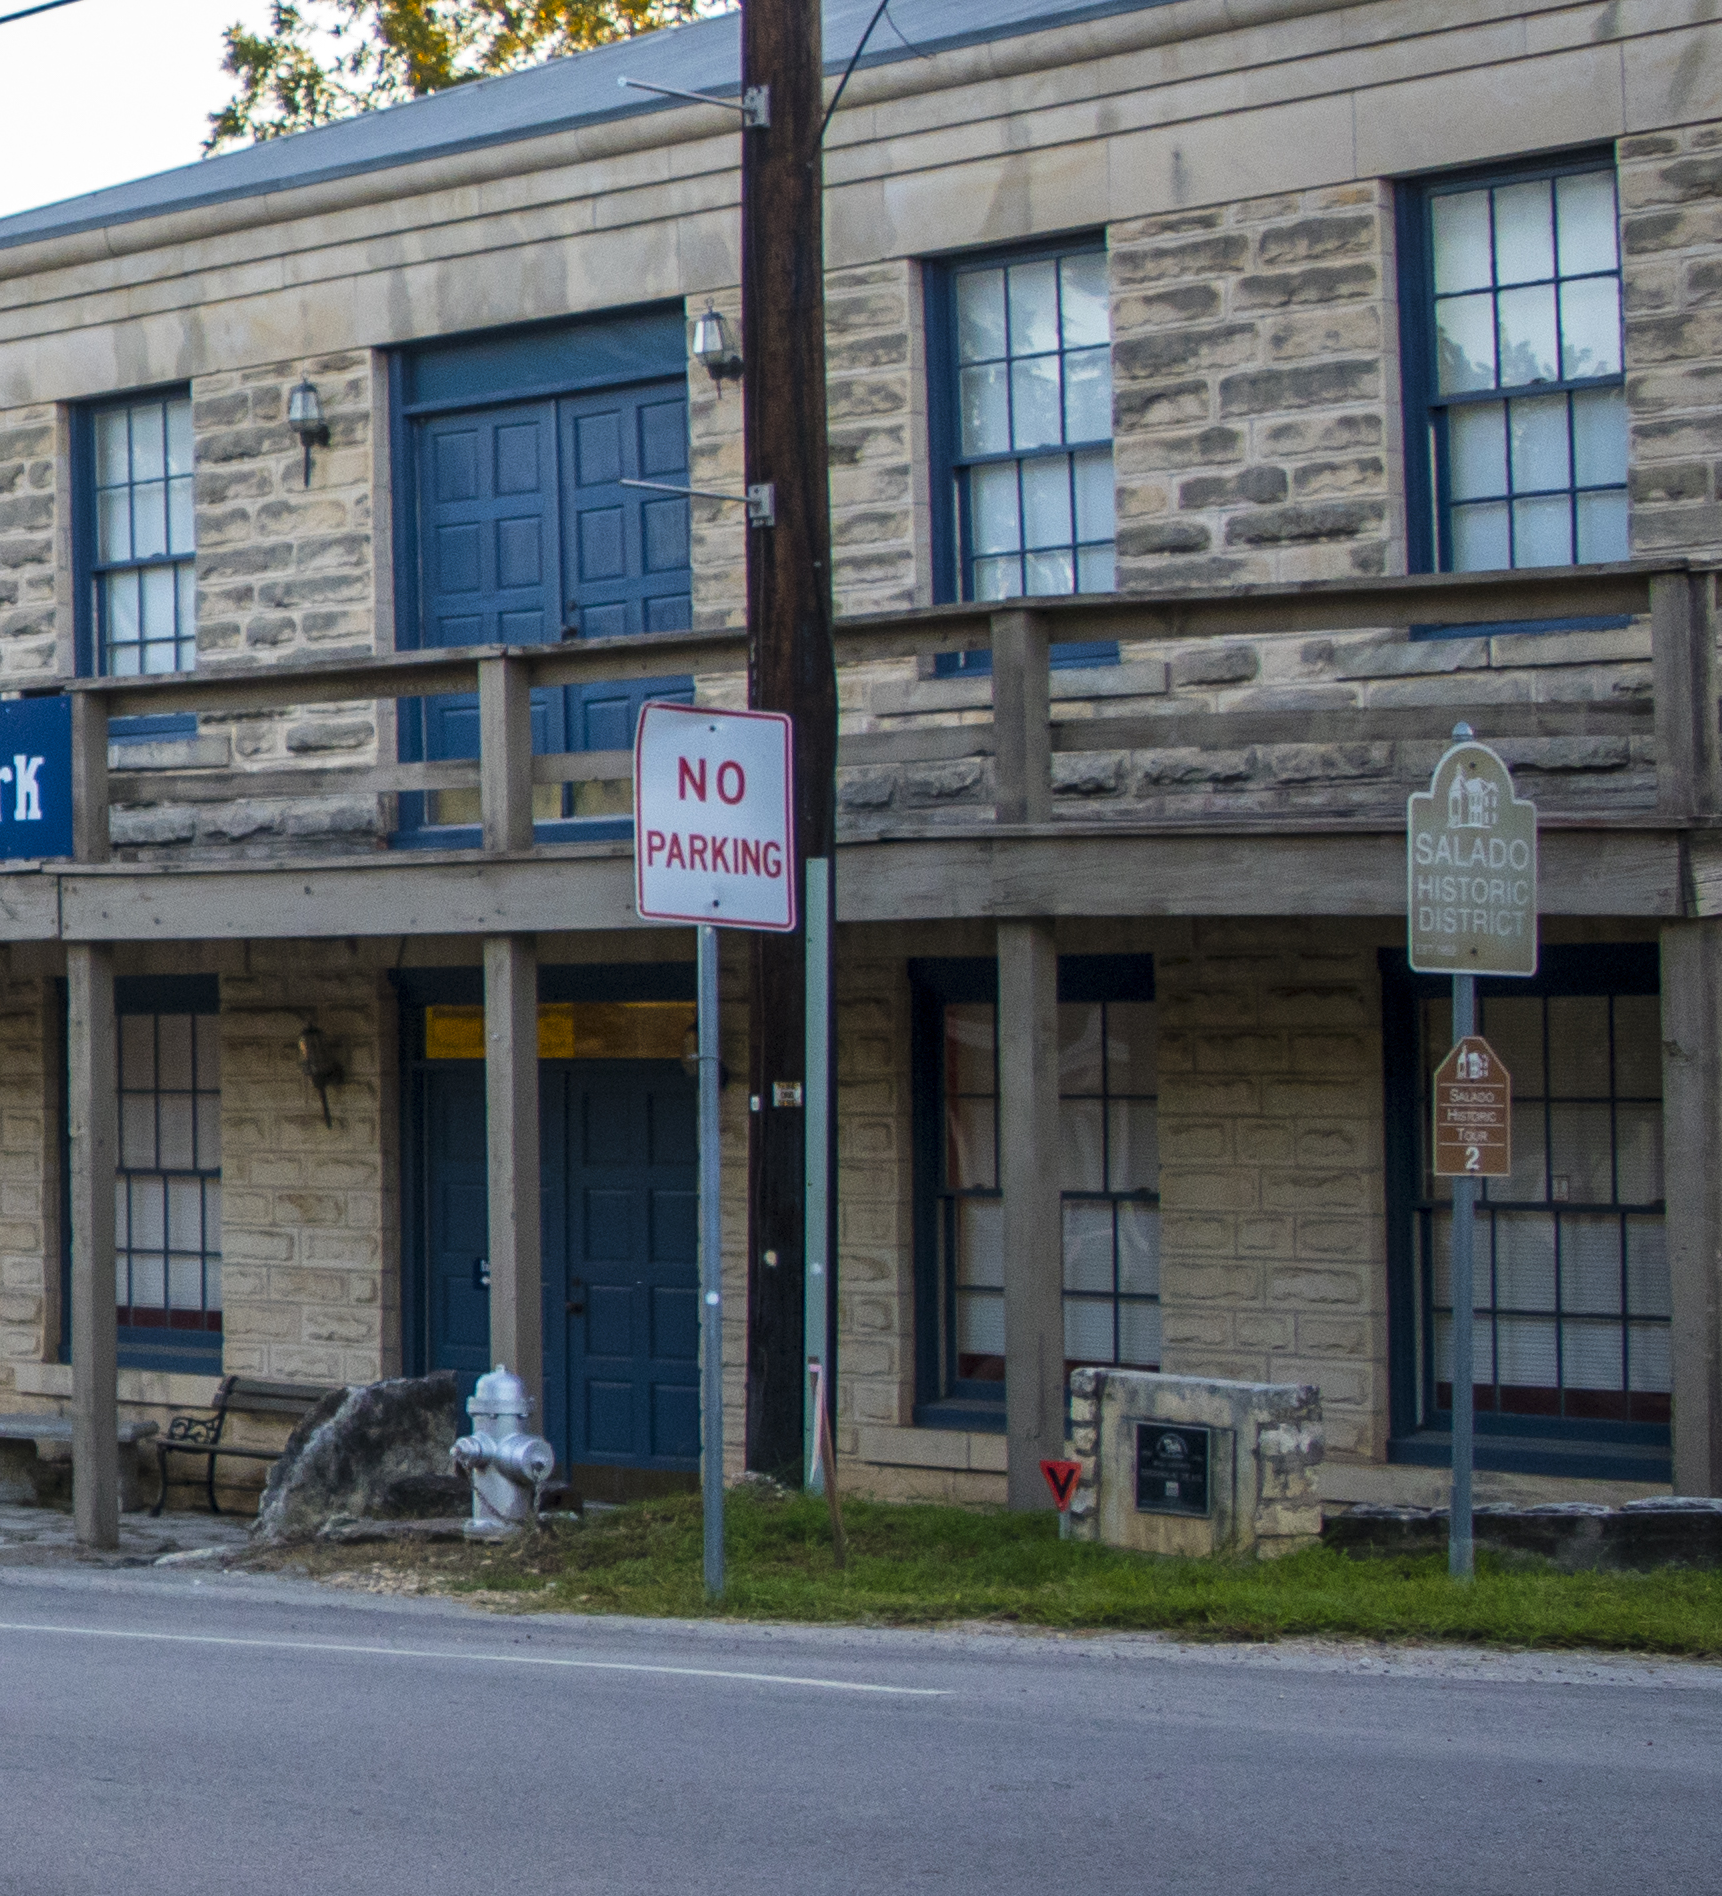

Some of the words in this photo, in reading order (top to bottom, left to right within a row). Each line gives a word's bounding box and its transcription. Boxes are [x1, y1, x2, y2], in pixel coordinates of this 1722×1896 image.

[678, 756, 746, 805] NO
[647, 830, 782, 879] PARKING
[1416, 832, 1529, 871] SALADO
[1417, 875, 1530, 905] HISTORIC
[1419, 906, 1525, 936] DISTRICT
[1465, 1146, 1480, 1170] 2
